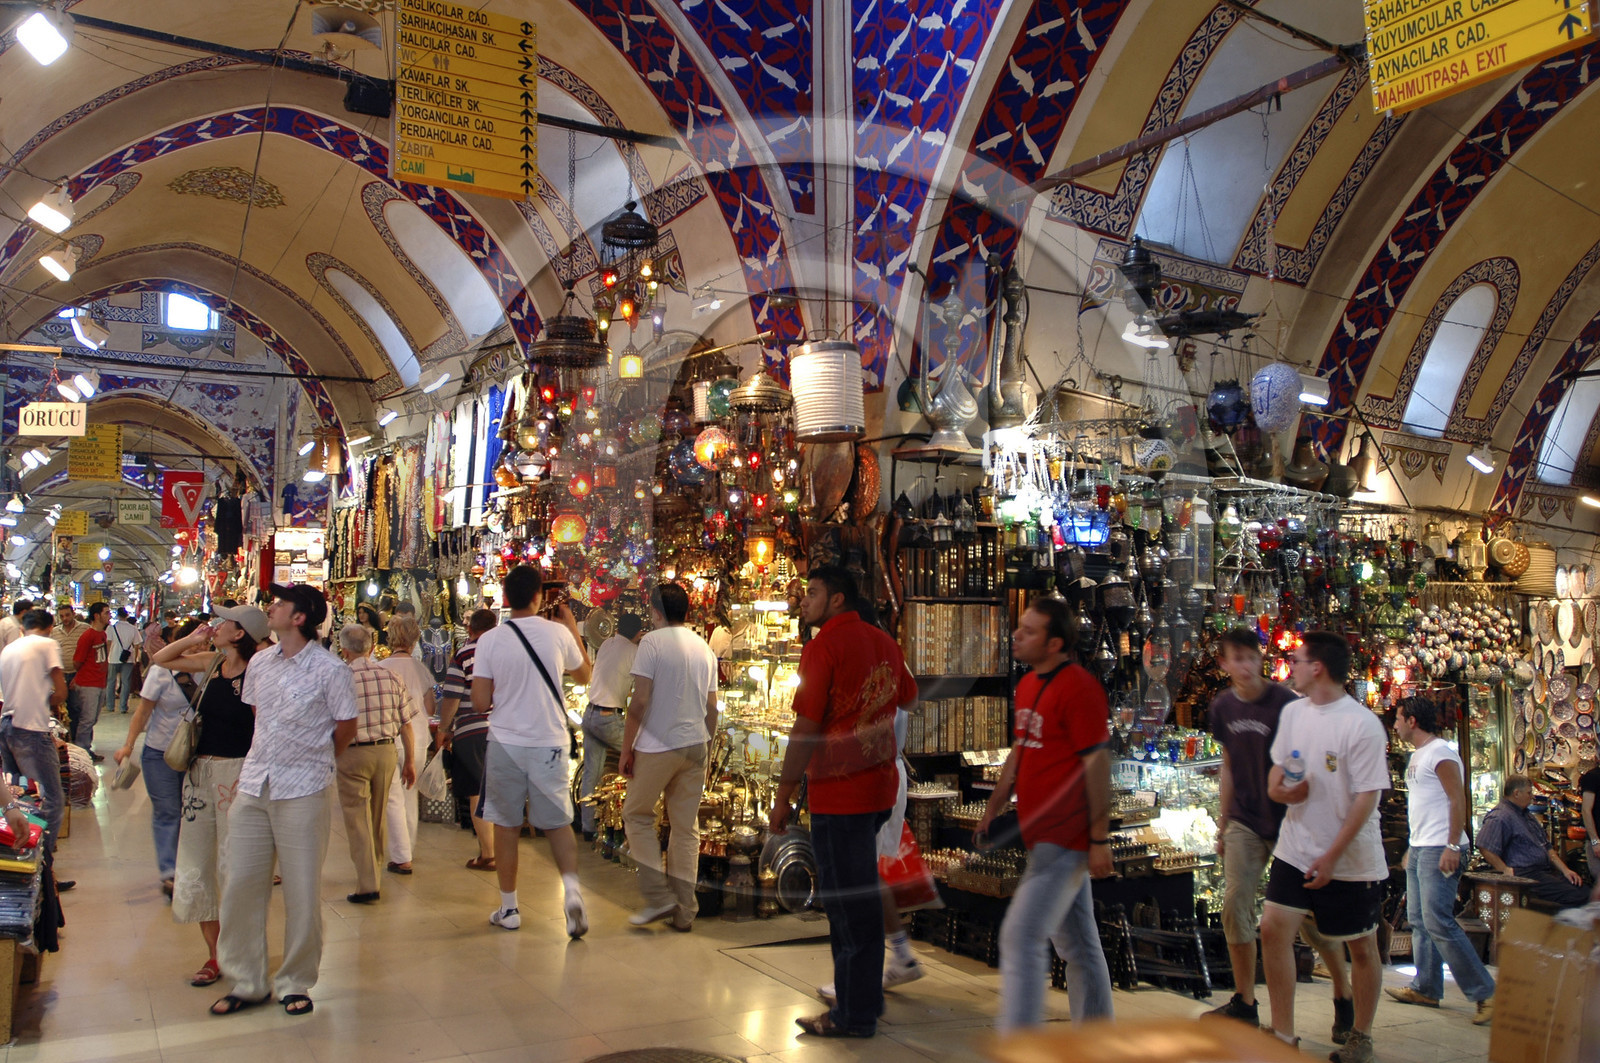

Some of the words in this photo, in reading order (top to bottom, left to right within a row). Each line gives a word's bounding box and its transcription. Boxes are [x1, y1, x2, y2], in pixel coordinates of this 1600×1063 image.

[401, 13, 477, 41] SARIHACIHASAN
[482, 31, 496, 46] SK.
[468, 10, 490, 26] CAD.
[1372, 1, 1463, 56] KUYUMCULAR
[401, 31, 450, 53] HALICILAR
[455, 43, 477, 59] CAD.
[401, 48, 417, 62] WC
[1376, 37, 1449, 82] AYNACILAR
[1456, 22, 1490, 49] CAD.
[401, 67, 450, 89] KAVAFLAR
[455, 79, 470, 93] SK.
[1378, 59, 1470, 109] MAHMUTPAŞA
[1476, 43, 1508, 72] EXIT
[401, 85, 462, 109] TERLİKÇİLER
[467, 99, 482, 113] SK.
[401, 104, 470, 129] YORGANCILAR
[474, 119, 496, 134] CAD.
[401, 122, 467, 146] PERDAHÇILAR
[472, 136, 494, 151] CAD.
[401, 141, 434, 159] ZABITA
[401, 160, 425, 175] CAMİ
[23, 408, 81, 427] ÖRÜCÜ
